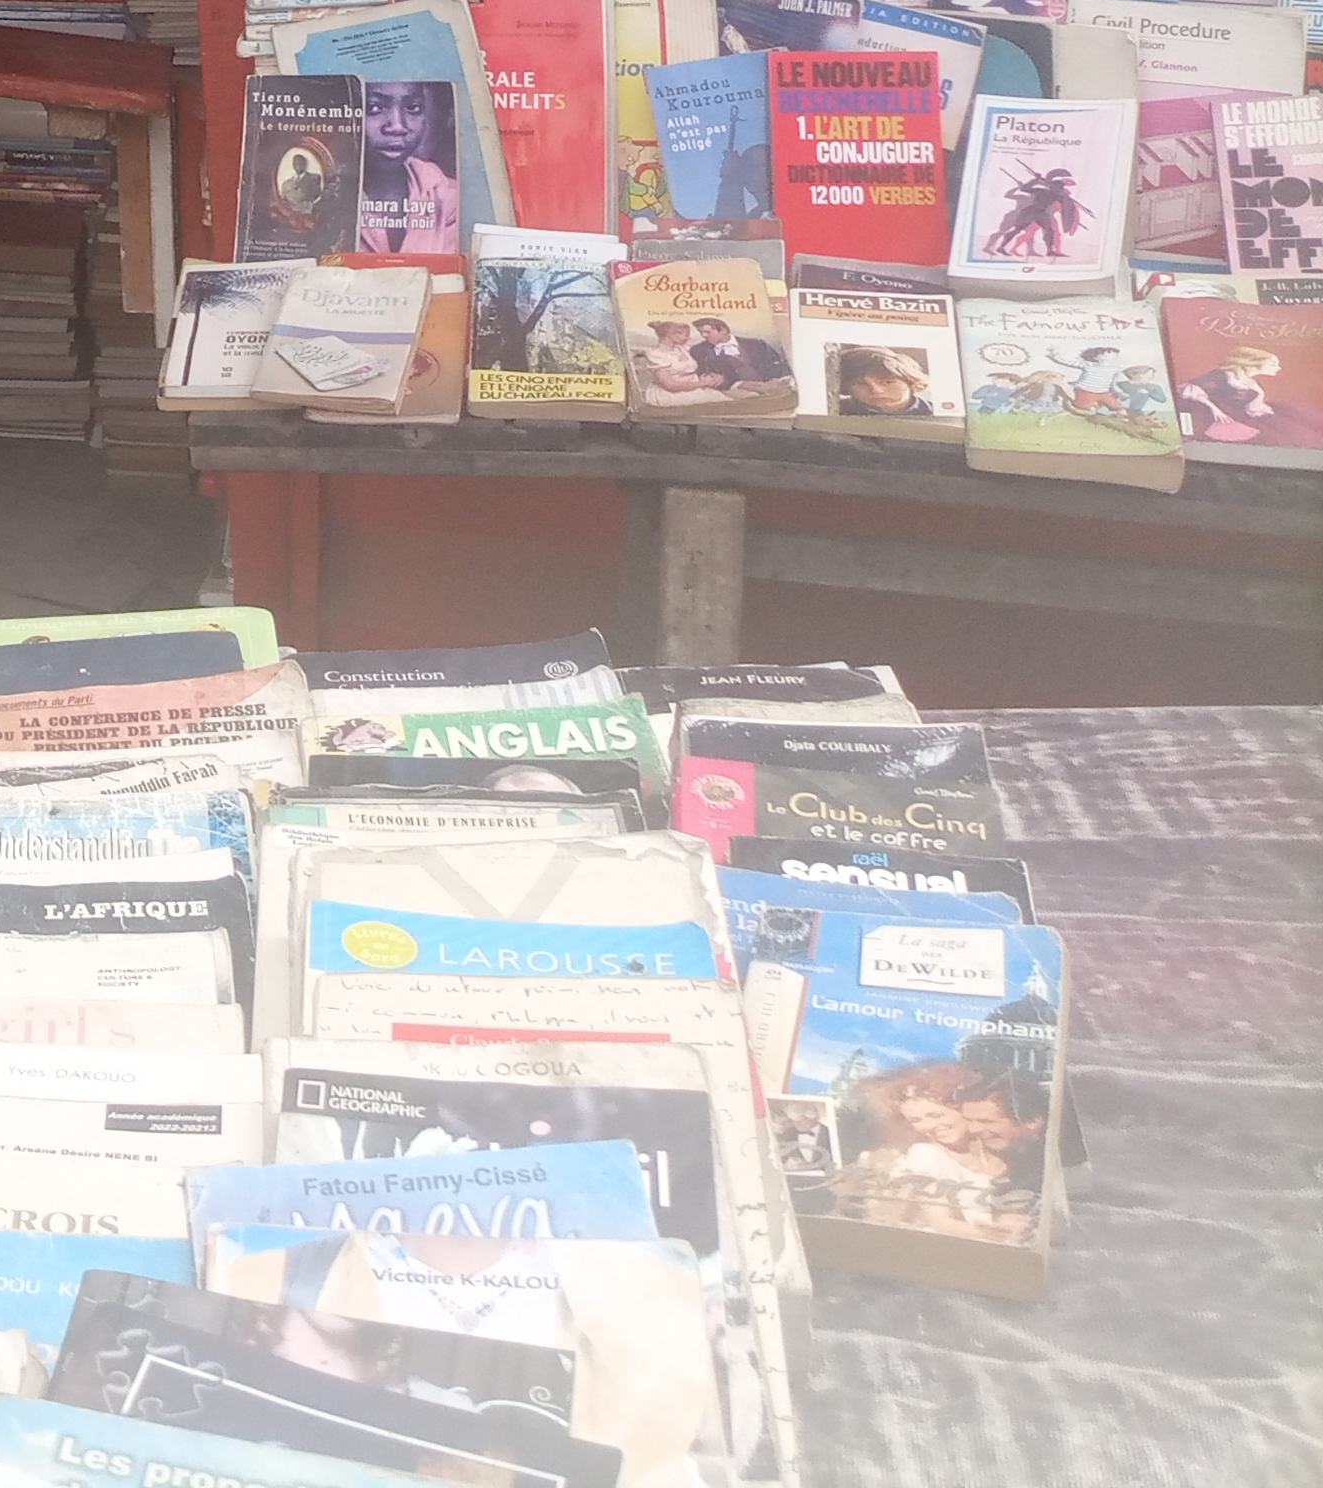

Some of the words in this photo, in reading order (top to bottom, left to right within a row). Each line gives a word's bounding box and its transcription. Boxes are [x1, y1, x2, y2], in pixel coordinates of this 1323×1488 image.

[776, 61, 808, 88] LE
[812, 60, 932, 88] NOUVEAU
[1151, 60, 1198, 75] Glannon
[252, 92, 301, 103] Tierno
[655, 75, 732, 100] Ahmadou
[666, 86, 765, 112] Kourouma
[261, 104, 363, 119] Monénembo
[777, 89, 933, 112] BESCHERELLE
[260, 121, 273, 132] Le
[277, 121, 334, 134] terroriste
[338, 122, 362, 133] noir
[667, 114, 700, 128] Allah
[669, 128, 701, 141] n'est
[706, 124, 729, 138] pas
[796, 116, 813, 141] 1.
[813, 114, 873, 141] L'ART
[877, 115, 905, 140] DE
[995, 115, 1066, 134] Platon
[671, 137, 713, 153] obligé
[995, 134, 1010, 145] La
[1011, 135, 1082, 148] République
[816, 141, 935, 165] CONJUGUER
[644, 274, 729, 294] Barbara
[672, 290, 757, 313] Cartland
[805, 293, 874, 311] Hervé
[878, 296, 941, 314] Bazin
[323, 670, 445, 682] Constitution
[20, 717, 41, 728] LA
[48, 711, 161, 727] CONFÉRENCE
[168, 708, 192, 719] DE
[199, 704, 267, 718] PRESSE
[22, 726, 120, 741] PRÉSIDENT
[127, 725, 151, 736] DE
[158, 723, 181, 735] LA
[187, 717, 299, 733] RÉPUBLIQUE
[412, 714, 638, 760] ANGLAIS
[789, 792, 866, 824] Club
[872, 814, 903, 827] des
[906, 803, 987, 840] Cinq
[811, 824, 834, 838] et
[844, 825, 863, 841] le
[871, 829, 947, 851] coffre
[44, 900, 209, 920] L'AFRIQUE
[438, 943, 677, 975] LAROUSSE
[811, 994, 904, 1019] L'amour
[915, 1008, 1057, 1040] triomphant
[329, 1085, 406, 1104] NATIONAL
[329, 1099, 426, 1118] GEOGRAPHIC
[302, 1175, 376, 1198] Fatou
[383, 1162, 548, 1194] Fanny-Cissé
[372, 1266, 454, 1289] Victoire
[459, 1274, 559, 1291] K-KALOU
[58, 1436, 133, 1476] Les
